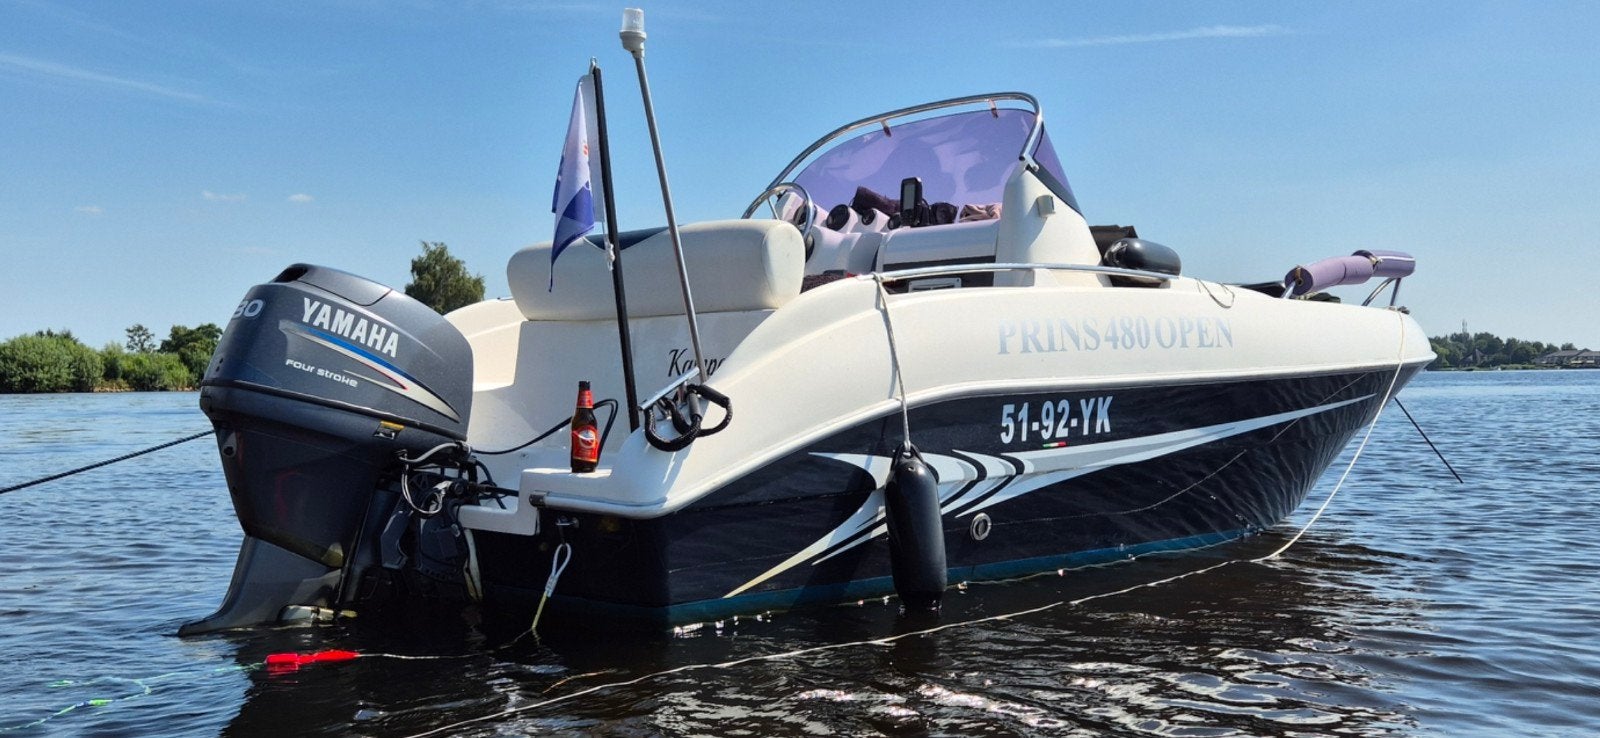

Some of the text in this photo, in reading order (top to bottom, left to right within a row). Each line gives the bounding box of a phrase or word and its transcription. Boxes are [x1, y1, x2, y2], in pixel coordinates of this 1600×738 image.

[302, 297, 399, 358] YAMAHA
[998, 315, 1234, 355] PRINS 480 OPEN
[1000, 395, 1114, 444] 51-92-YK
